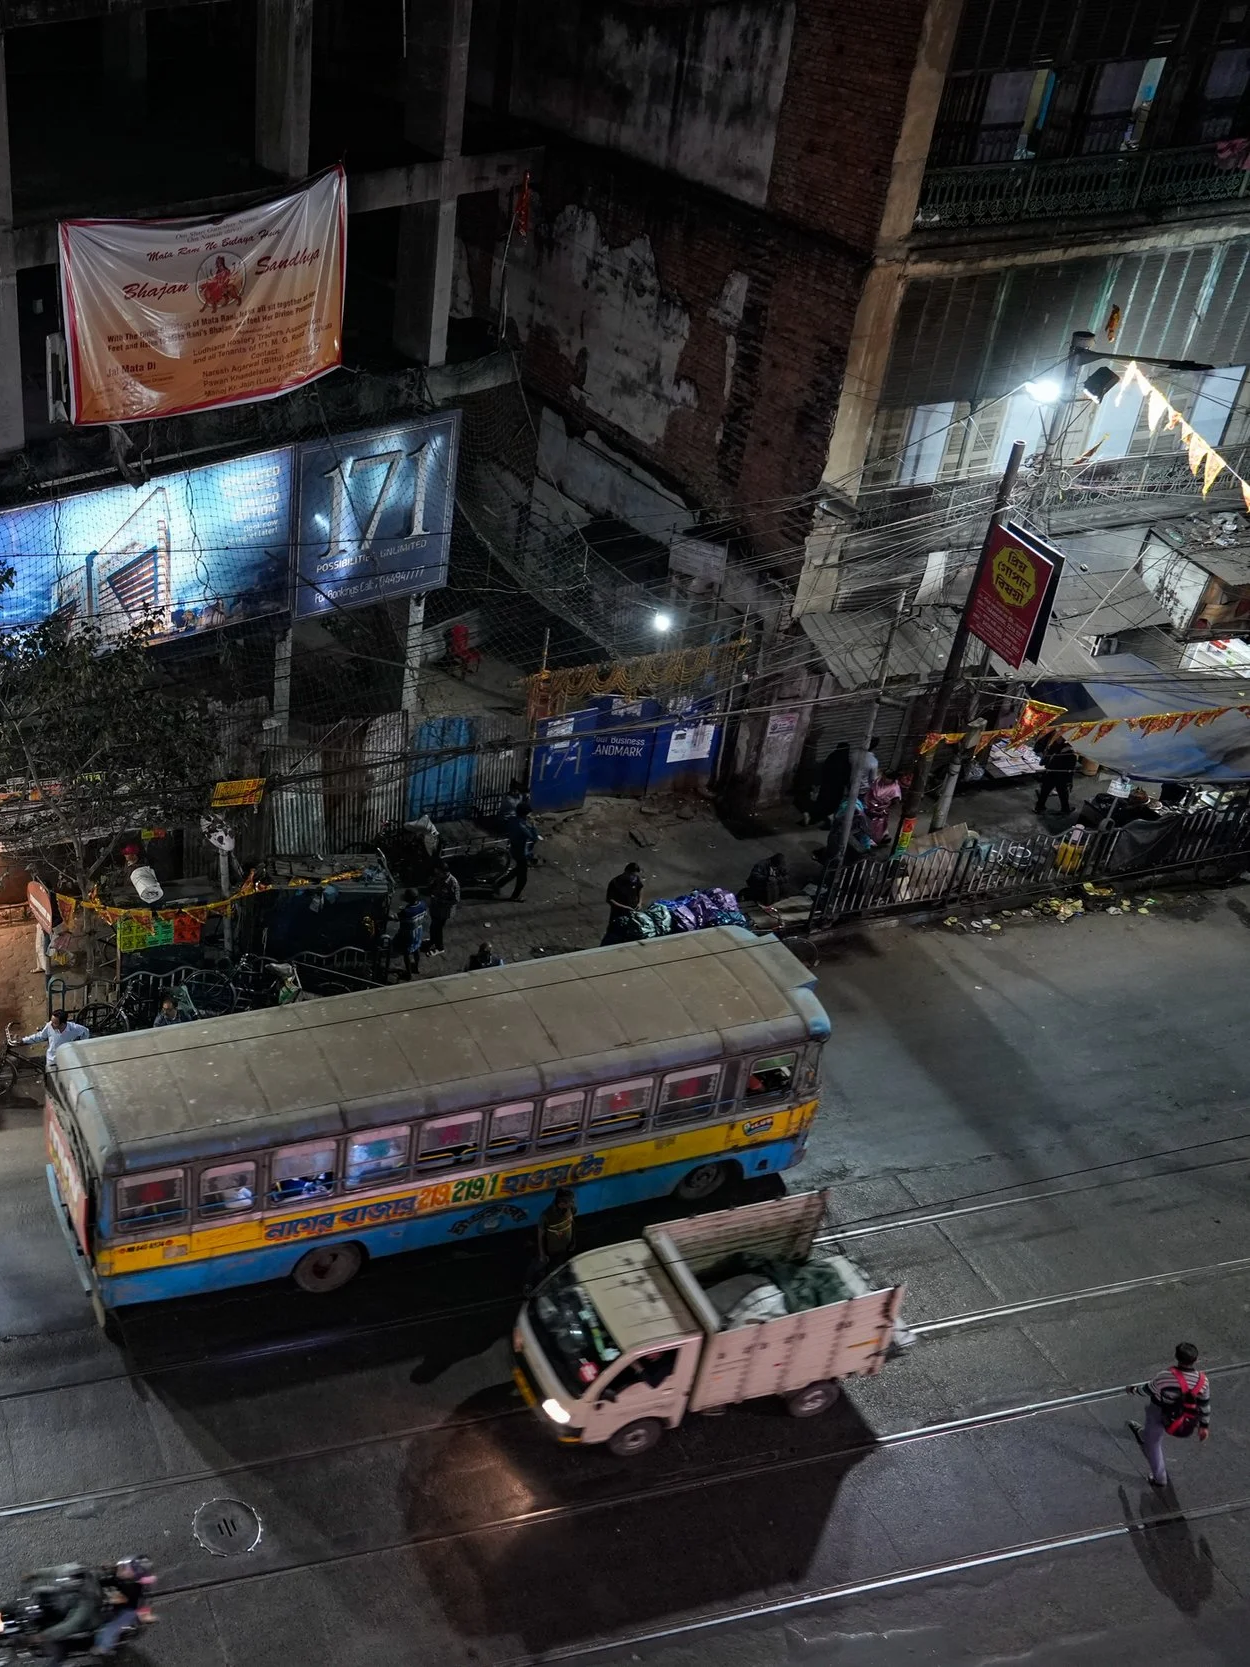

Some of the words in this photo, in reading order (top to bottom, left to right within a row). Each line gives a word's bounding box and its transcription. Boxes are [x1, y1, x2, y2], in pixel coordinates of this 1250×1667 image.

[147, 252, 173, 263] Mata
[221, 236, 254, 250] Bulaya
[254, 248, 320, 275] Sandhya
[122, 282, 189, 300] Bhajan
[126, 331, 138, 340] The
[321, 442, 431, 559] 171
[315, 553, 374, 572] POSSIBILITIE
[379, 539, 428, 557] UNLIMITED
[611, 735, 645, 748] Business
[338, 1197, 417, 1227] বাজার
[452, 1173, 500, 1203] 219/1
